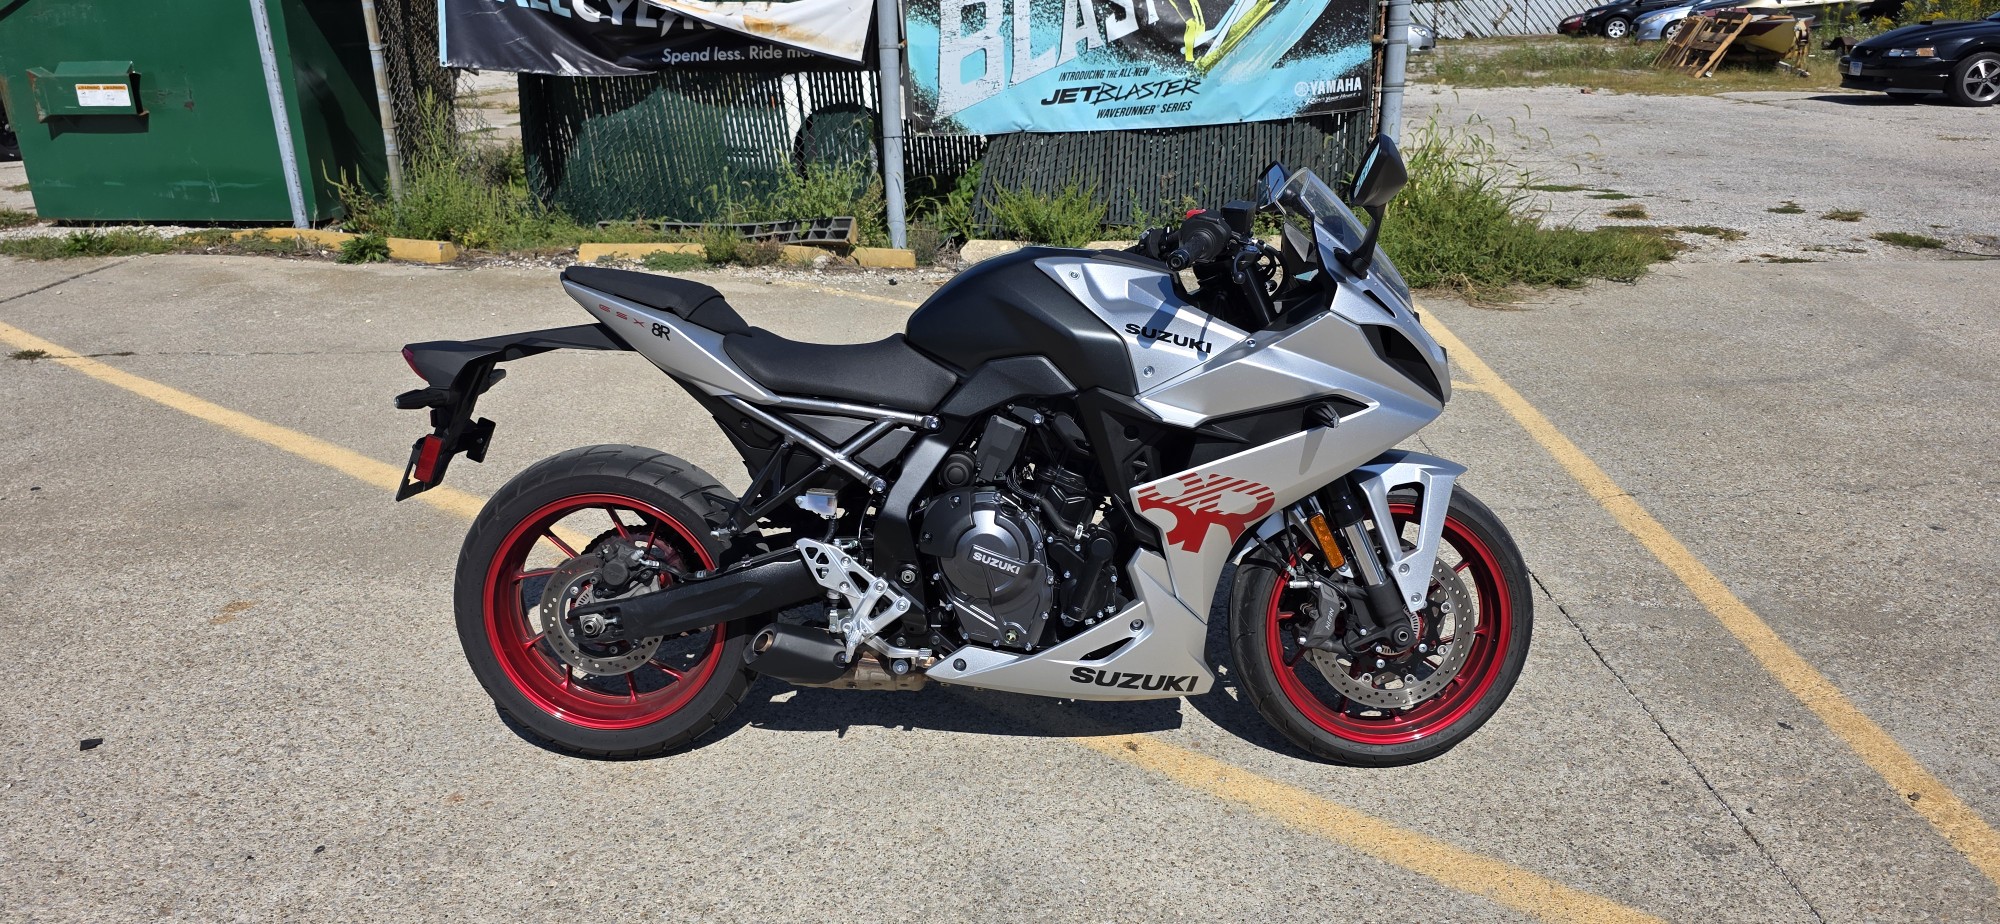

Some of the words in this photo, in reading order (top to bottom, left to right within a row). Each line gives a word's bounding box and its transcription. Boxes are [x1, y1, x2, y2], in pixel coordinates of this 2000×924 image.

[662, 47, 710, 65] Spend
[714, 47, 745, 61] less.
[750, 45, 783, 60] Ride
[932, 0, 1160, 119] BLAS
[1058, 68, 1105, 82] INTRODUCING
[1106, 70, 1118, 79] THE
[1119, 66, 1150, 78] ALL-NEW
[1309, 76, 1362, 96] YAMAHA
[1161, 101, 1193, 113] SERIES
[651, 322, 671, 342] 8R
[1124, 323, 1212, 354] SUZUKI
[972, 551, 1021, 575] SUZUKI
[1069, 666, 1199, 692] SUZUKI
